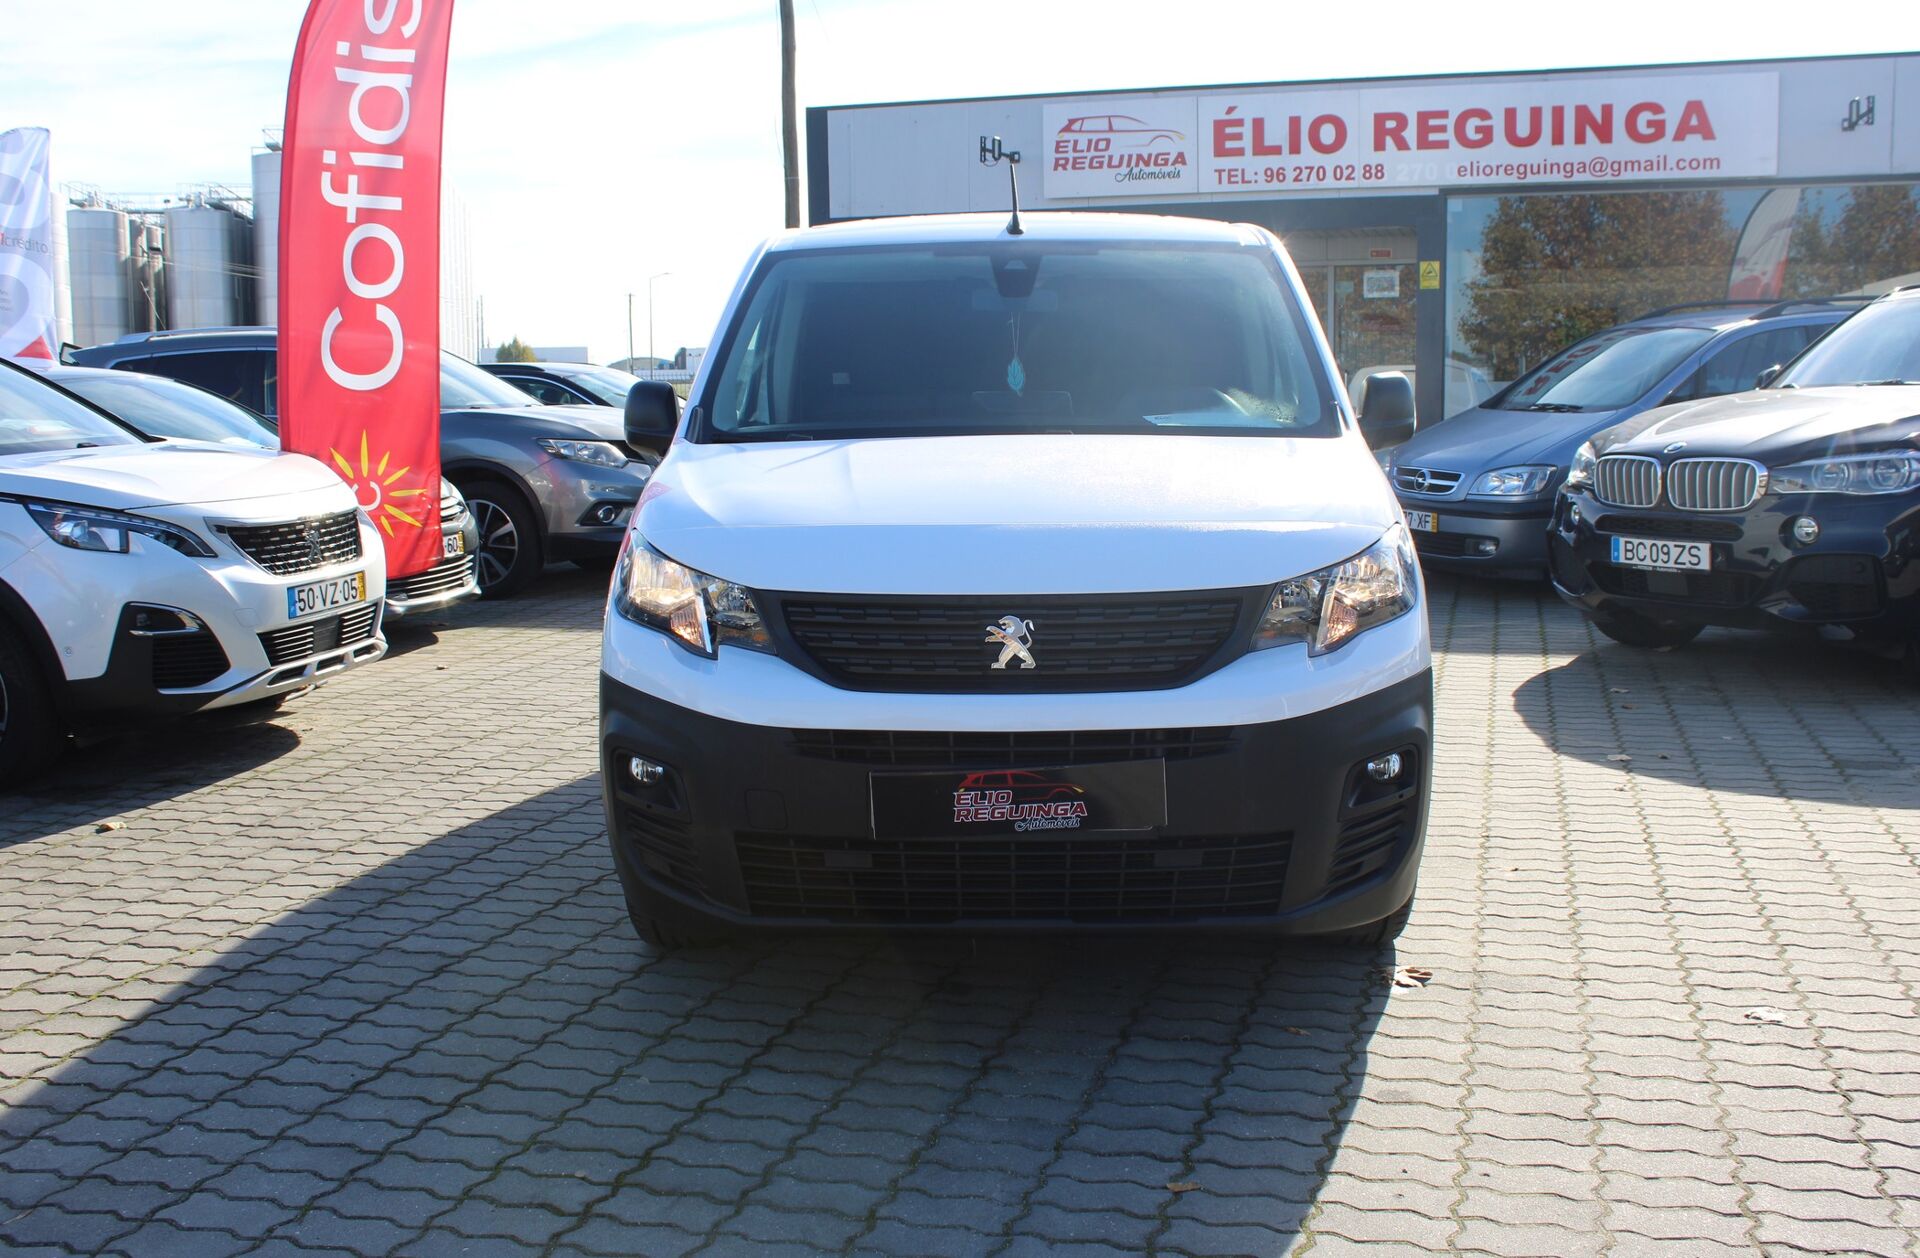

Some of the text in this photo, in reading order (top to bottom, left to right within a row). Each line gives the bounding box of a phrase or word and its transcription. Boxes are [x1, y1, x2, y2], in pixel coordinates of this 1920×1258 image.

[1213, 100, 1717, 158] ÉLIO REGUINGA
[1053, 151, 1188, 171] REGUINGA
[1214, 154, 1721, 185] TEL: 96 270 02 88 elioreguinga@gmail.com
[1114, 166, 1181, 183] Automóveis
[320, 0, 423, 392] Cofidis
[953, 801, 1088, 822] REGUINGA
